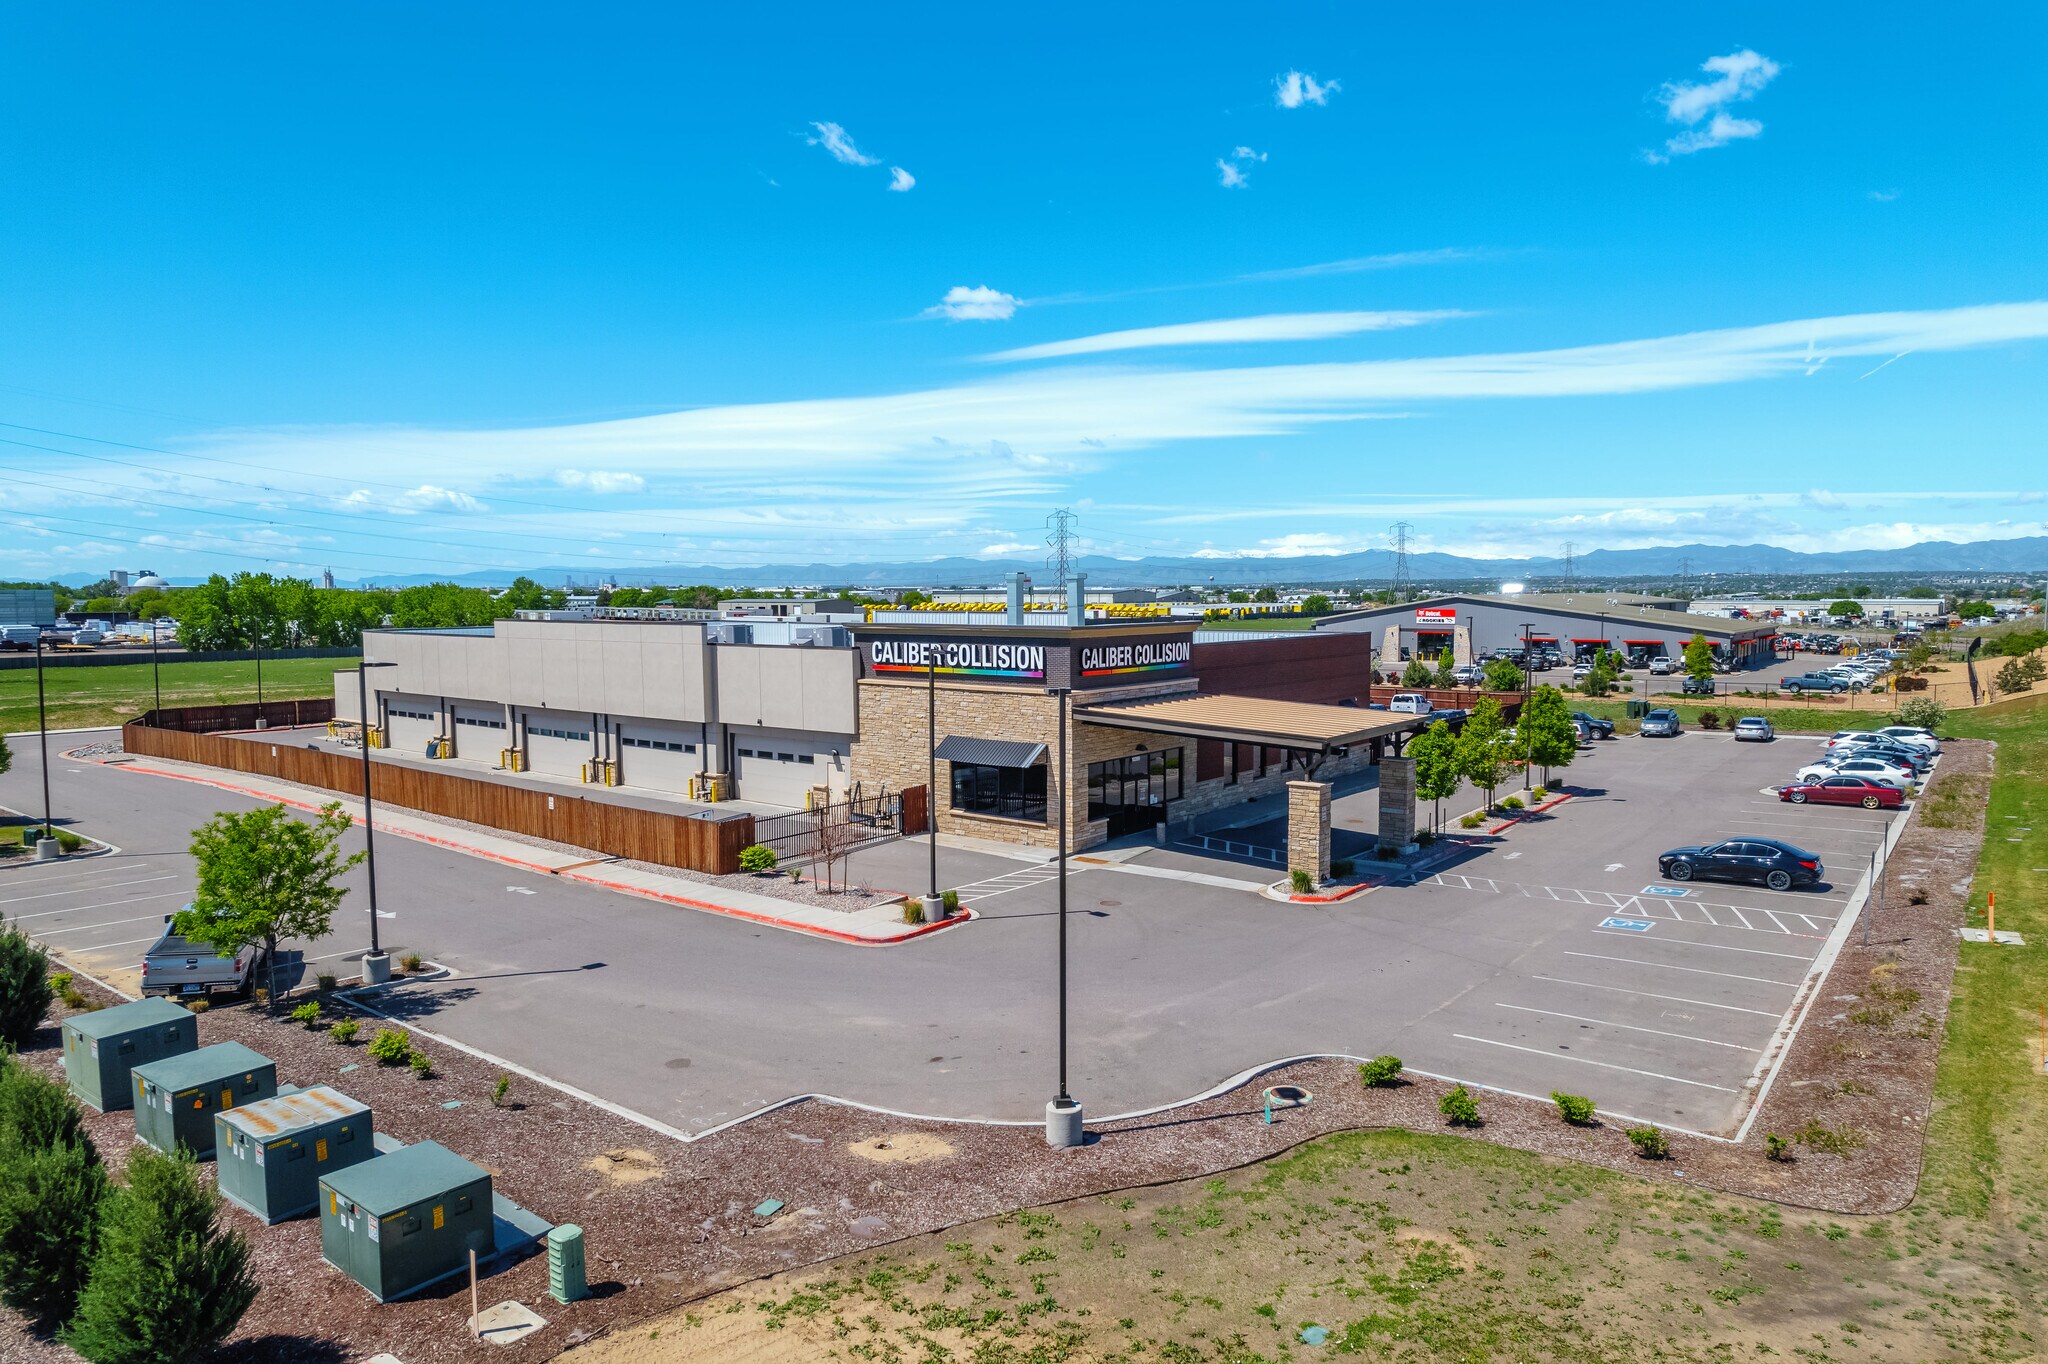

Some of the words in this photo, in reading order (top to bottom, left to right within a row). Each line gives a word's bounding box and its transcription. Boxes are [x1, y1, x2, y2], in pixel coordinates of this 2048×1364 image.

[871, 641, 942, 665] CALIBER
[947, 643, 1044, 670] COLLISION
[1082, 646, 1132, 669] CALIBER
[1135, 642, 1190, 665] COLLISION
